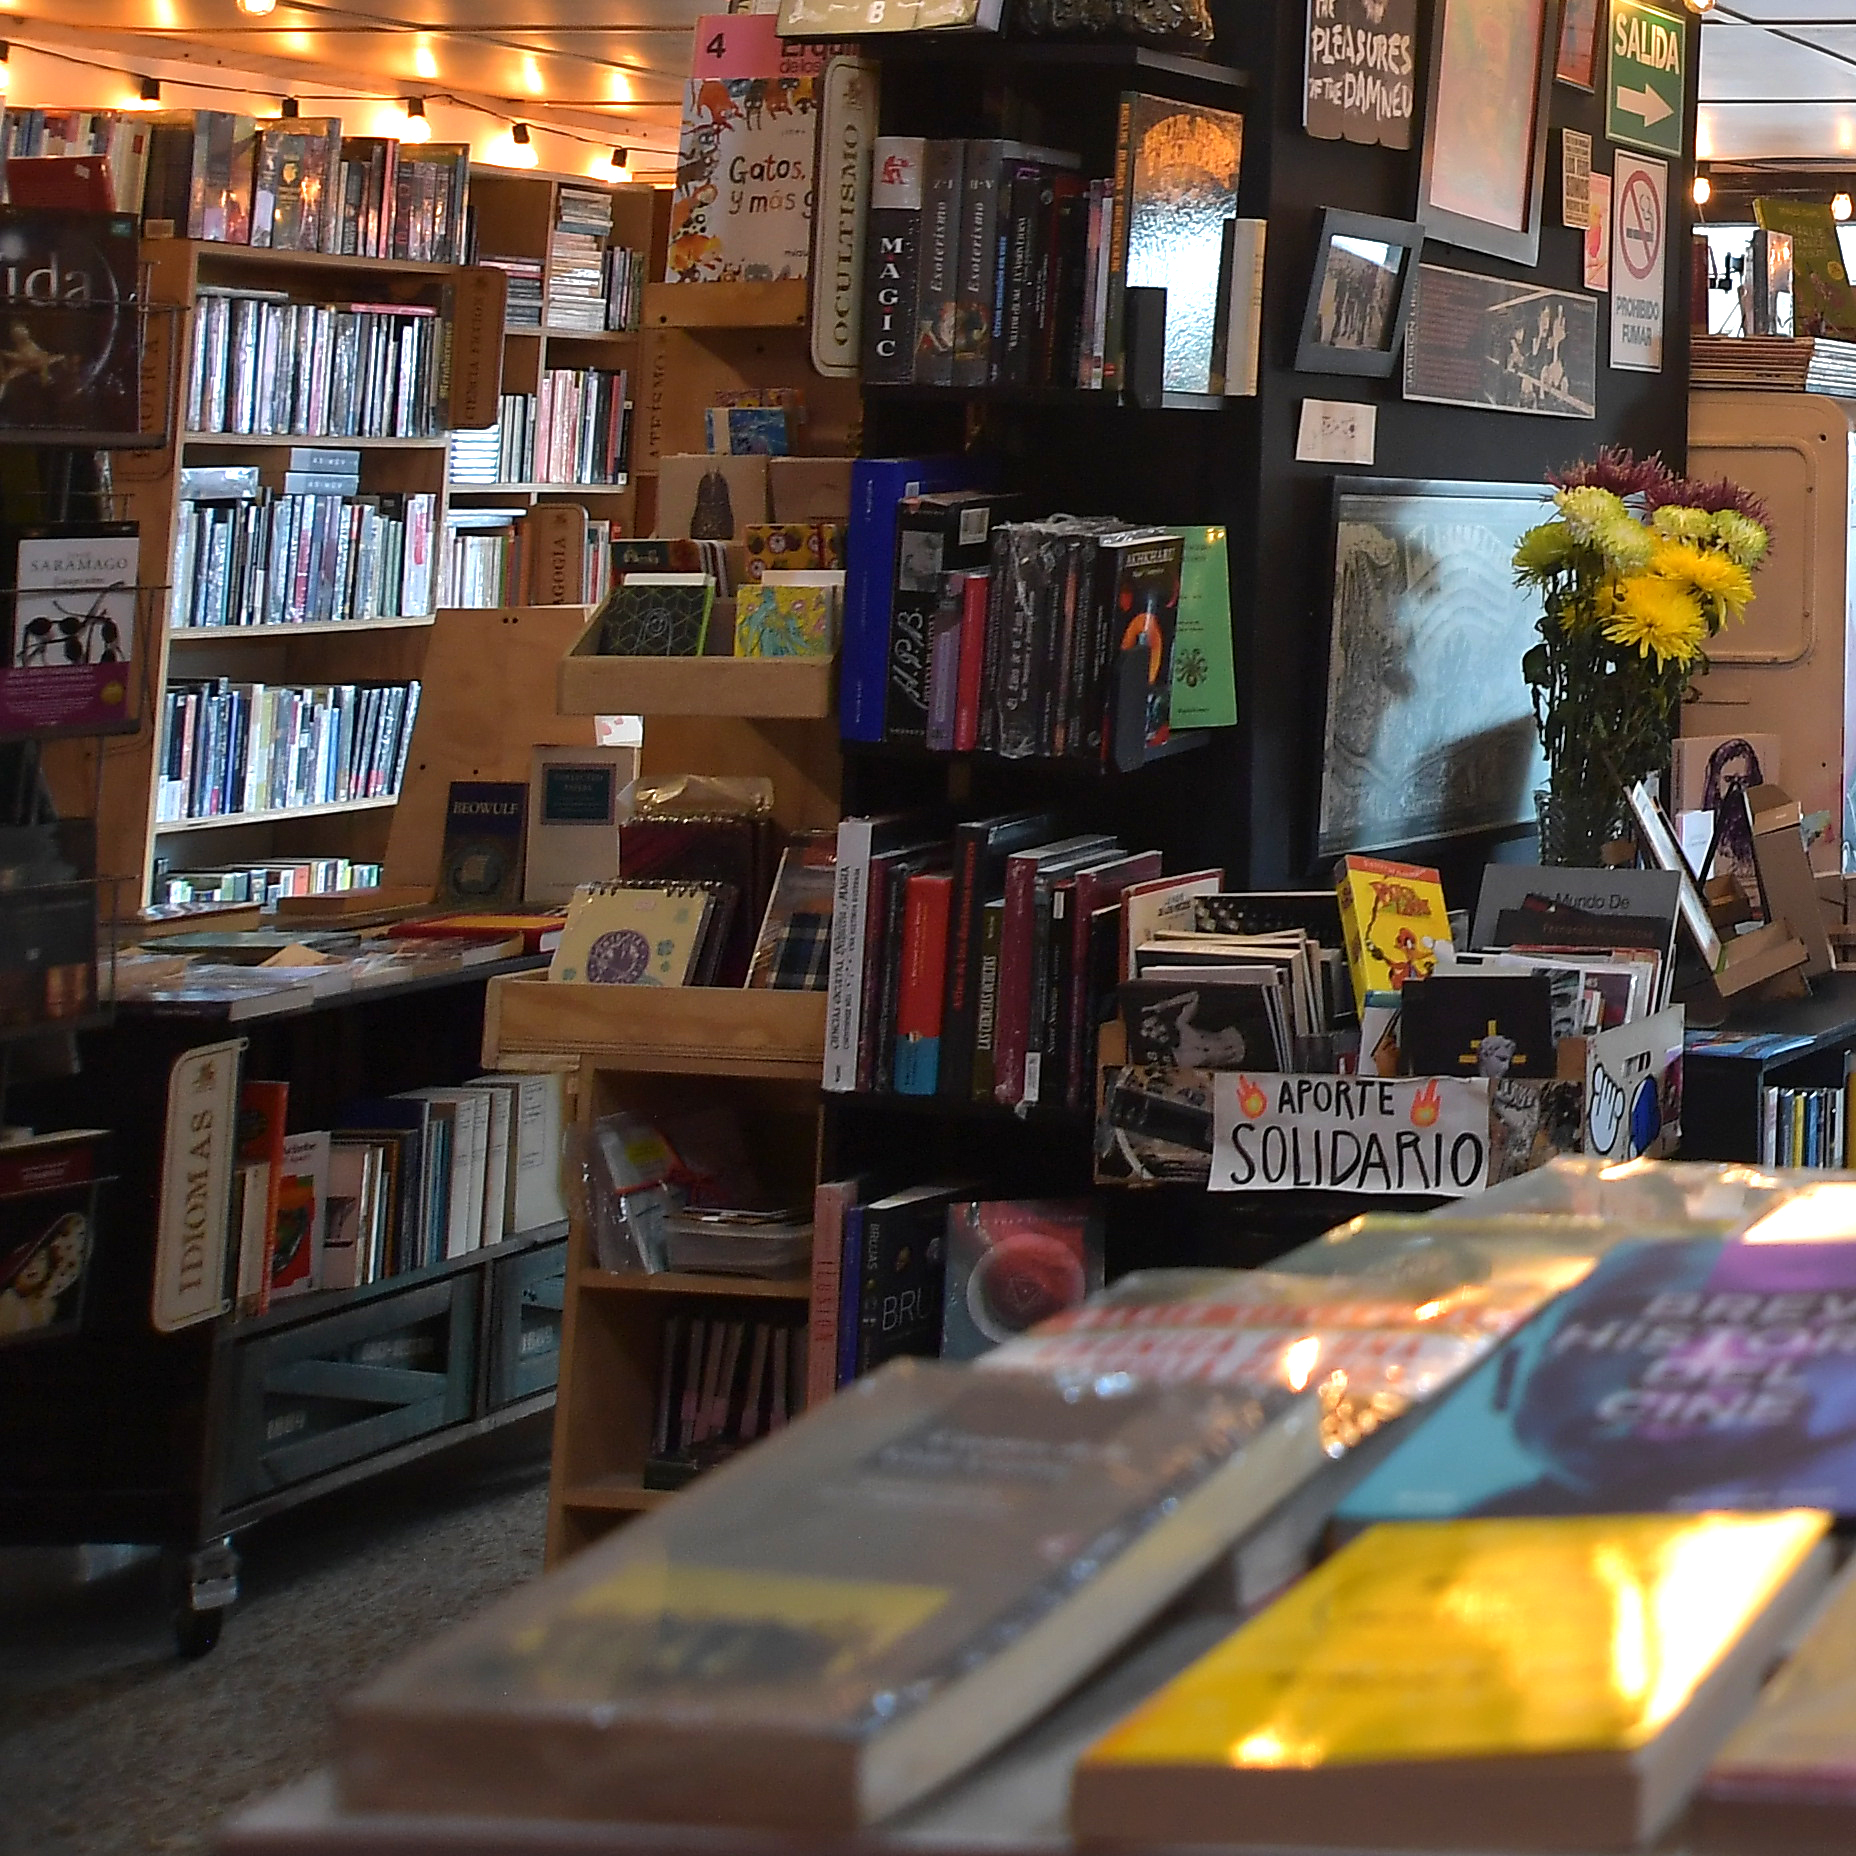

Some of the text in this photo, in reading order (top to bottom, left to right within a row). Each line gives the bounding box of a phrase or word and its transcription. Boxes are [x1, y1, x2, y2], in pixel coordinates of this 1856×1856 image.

[705, 32, 727, 59] 4
[1310, 24, 1413, 77] PLEASURES
[1614, 11, 1680, 75] SALIDA
[1343, 72, 1414, 123] DAMNED
[728, 155, 807, 186] Gatos,
[728, 190, 798, 216] y más
[832, 123, 860, 347] OCULTISMO
[4, 257, 92, 307] ida
[1615, 294, 1660, 322] PROHIBIDO
[1621, 321, 1653, 348] FUMAR
[645, 354, 664, 460] ATEÍSMO
[29, 557, 129, 573] SARAMAGO
[451, 798, 519, 817] BEOWULF
[1555, 892, 1631, 911] Mundo De
[977, 993, 995, 1033] CIENCIAS
[976, 1032, 992, 1051] LAS
[1277, 1079, 1396, 1119] APORTE
[1229, 1122, 1484, 1193] SOLIDARIO
[177, 1109, 213, 1296] IDIOMAS
[868, 1223, 881, 1270] BRUJAS
[1641, 1354, 1804, 1391] DEL
[1595, 1391, 1796, 1427] CINE
